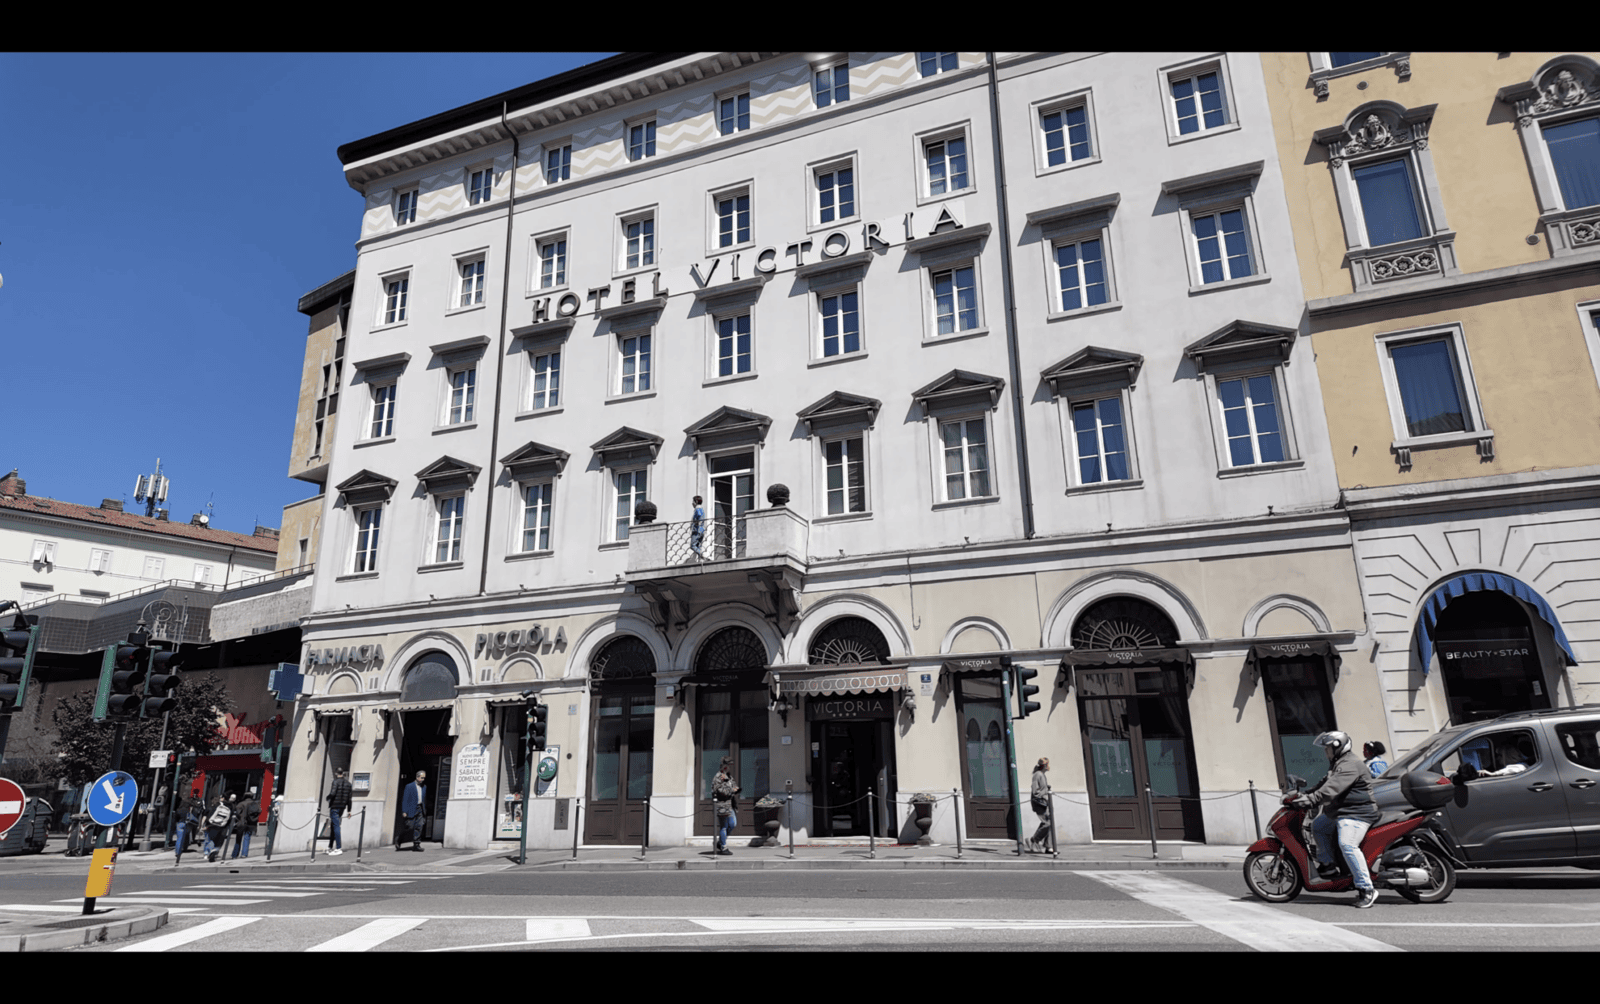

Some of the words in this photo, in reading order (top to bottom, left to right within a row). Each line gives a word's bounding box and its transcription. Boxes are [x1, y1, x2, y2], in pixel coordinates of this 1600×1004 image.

[532, 272, 669, 323] HOTEL
[692, 203, 964, 287] VICTORIA
[1271, 643, 1311, 651] VICTORIA
[307, 644, 385, 666] FARMACIA
[1107, 651, 1144, 659] VICTORIA
[1445, 650, 1492, 660] BEAUTY
[1499, 648, 1529, 657] STAR
[813, 700, 884, 714] VICTORIA
[460, 758, 486, 766] SEMPRE
